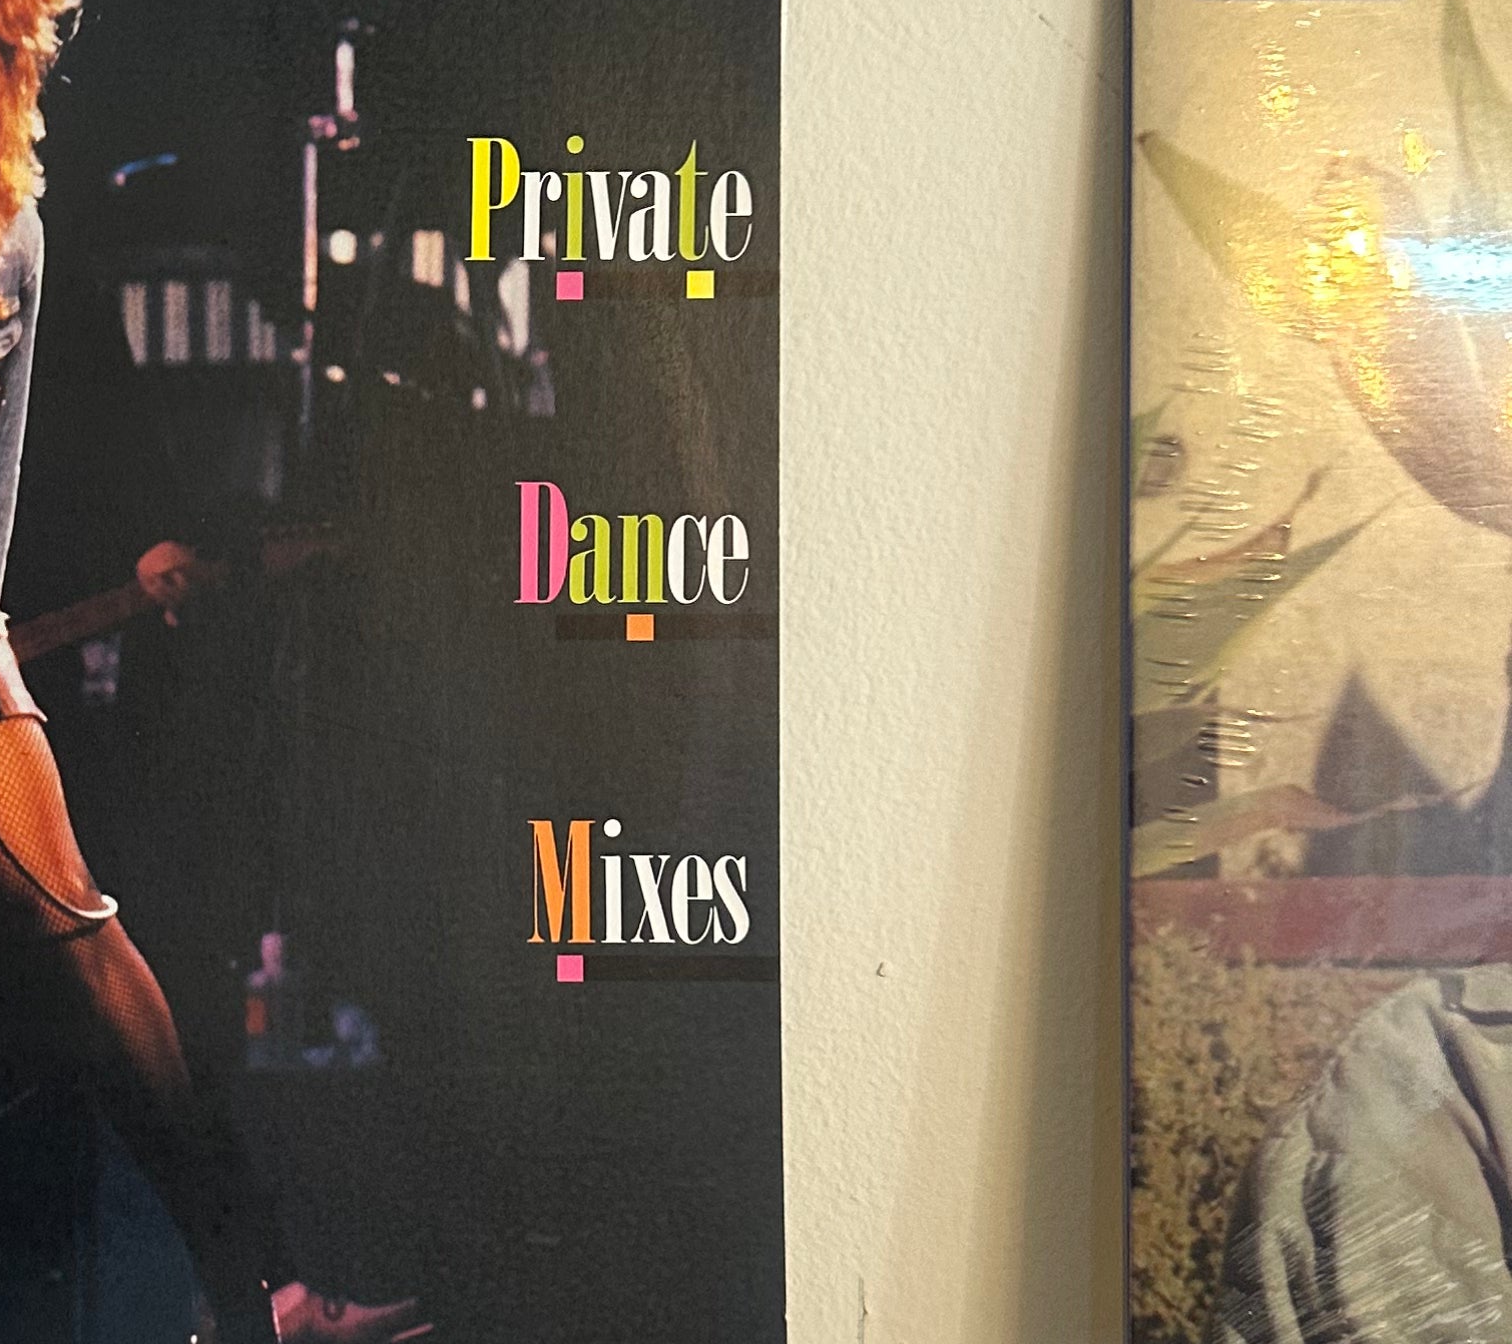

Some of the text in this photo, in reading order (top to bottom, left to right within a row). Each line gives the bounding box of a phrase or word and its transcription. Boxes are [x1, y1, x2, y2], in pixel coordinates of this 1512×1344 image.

[464, 134, 753, 262] Private
[513, 480, 751, 605] Dance
[526, 817, 751, 946] Mixes
